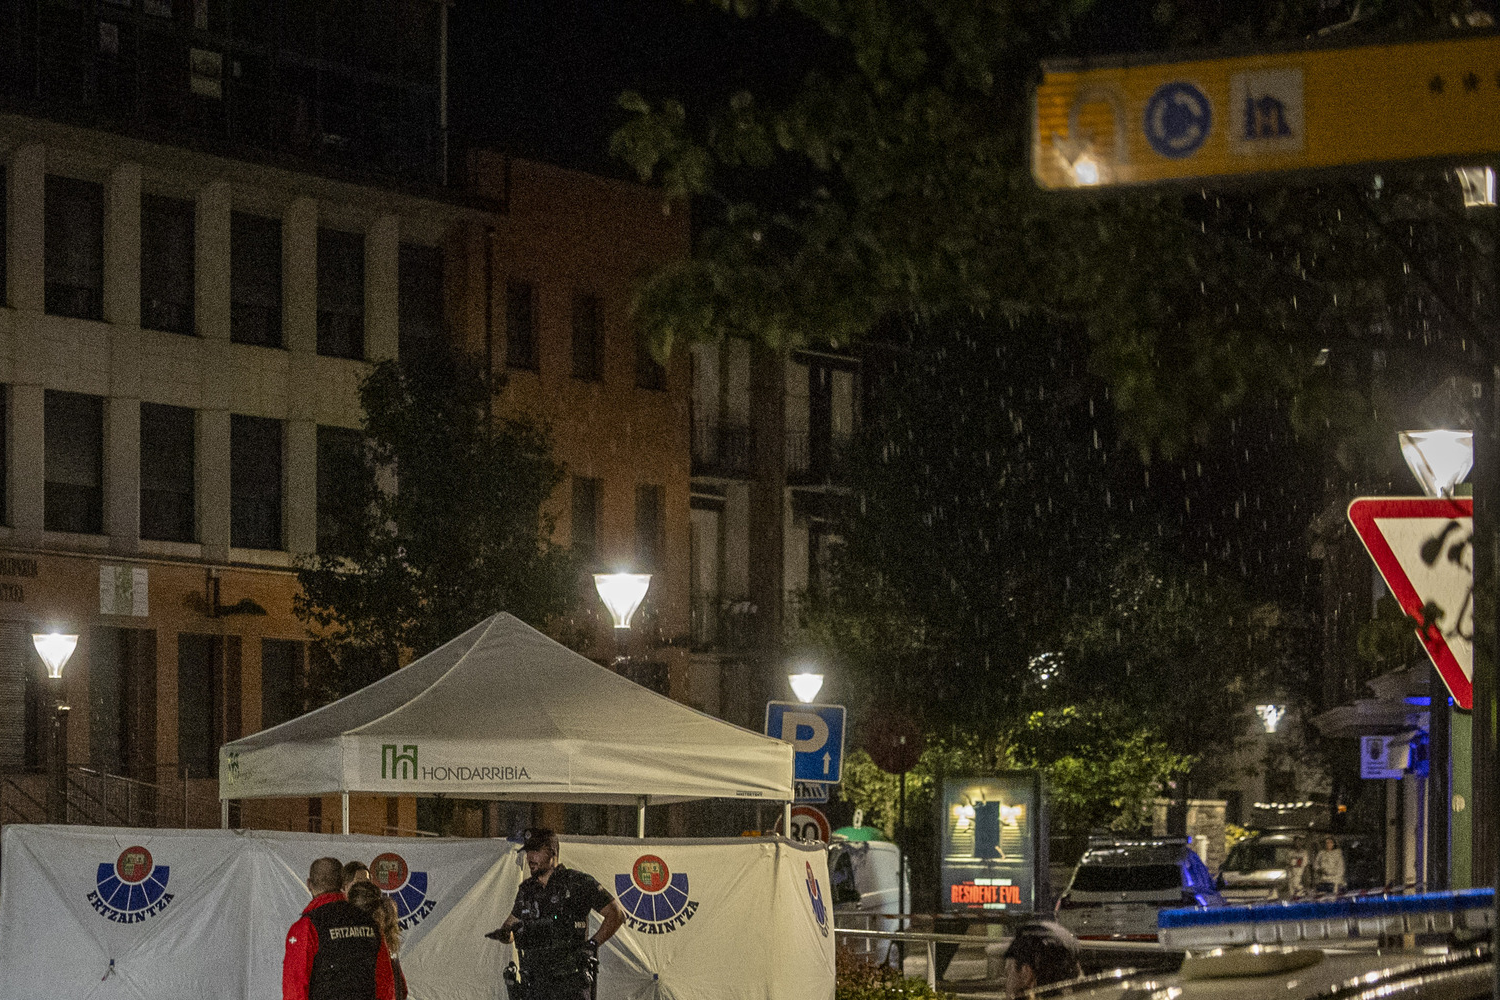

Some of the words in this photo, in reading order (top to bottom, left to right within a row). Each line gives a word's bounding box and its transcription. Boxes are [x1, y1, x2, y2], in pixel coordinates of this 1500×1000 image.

[781, 711, 829, 753] P
[86, 889, 175, 924] ERTZAINTZA
[951, 885, 998, 903] RESIDENT
[1000, 886, 1021, 904] EVIL
[623, 900, 699, 935] TZAINTZA
